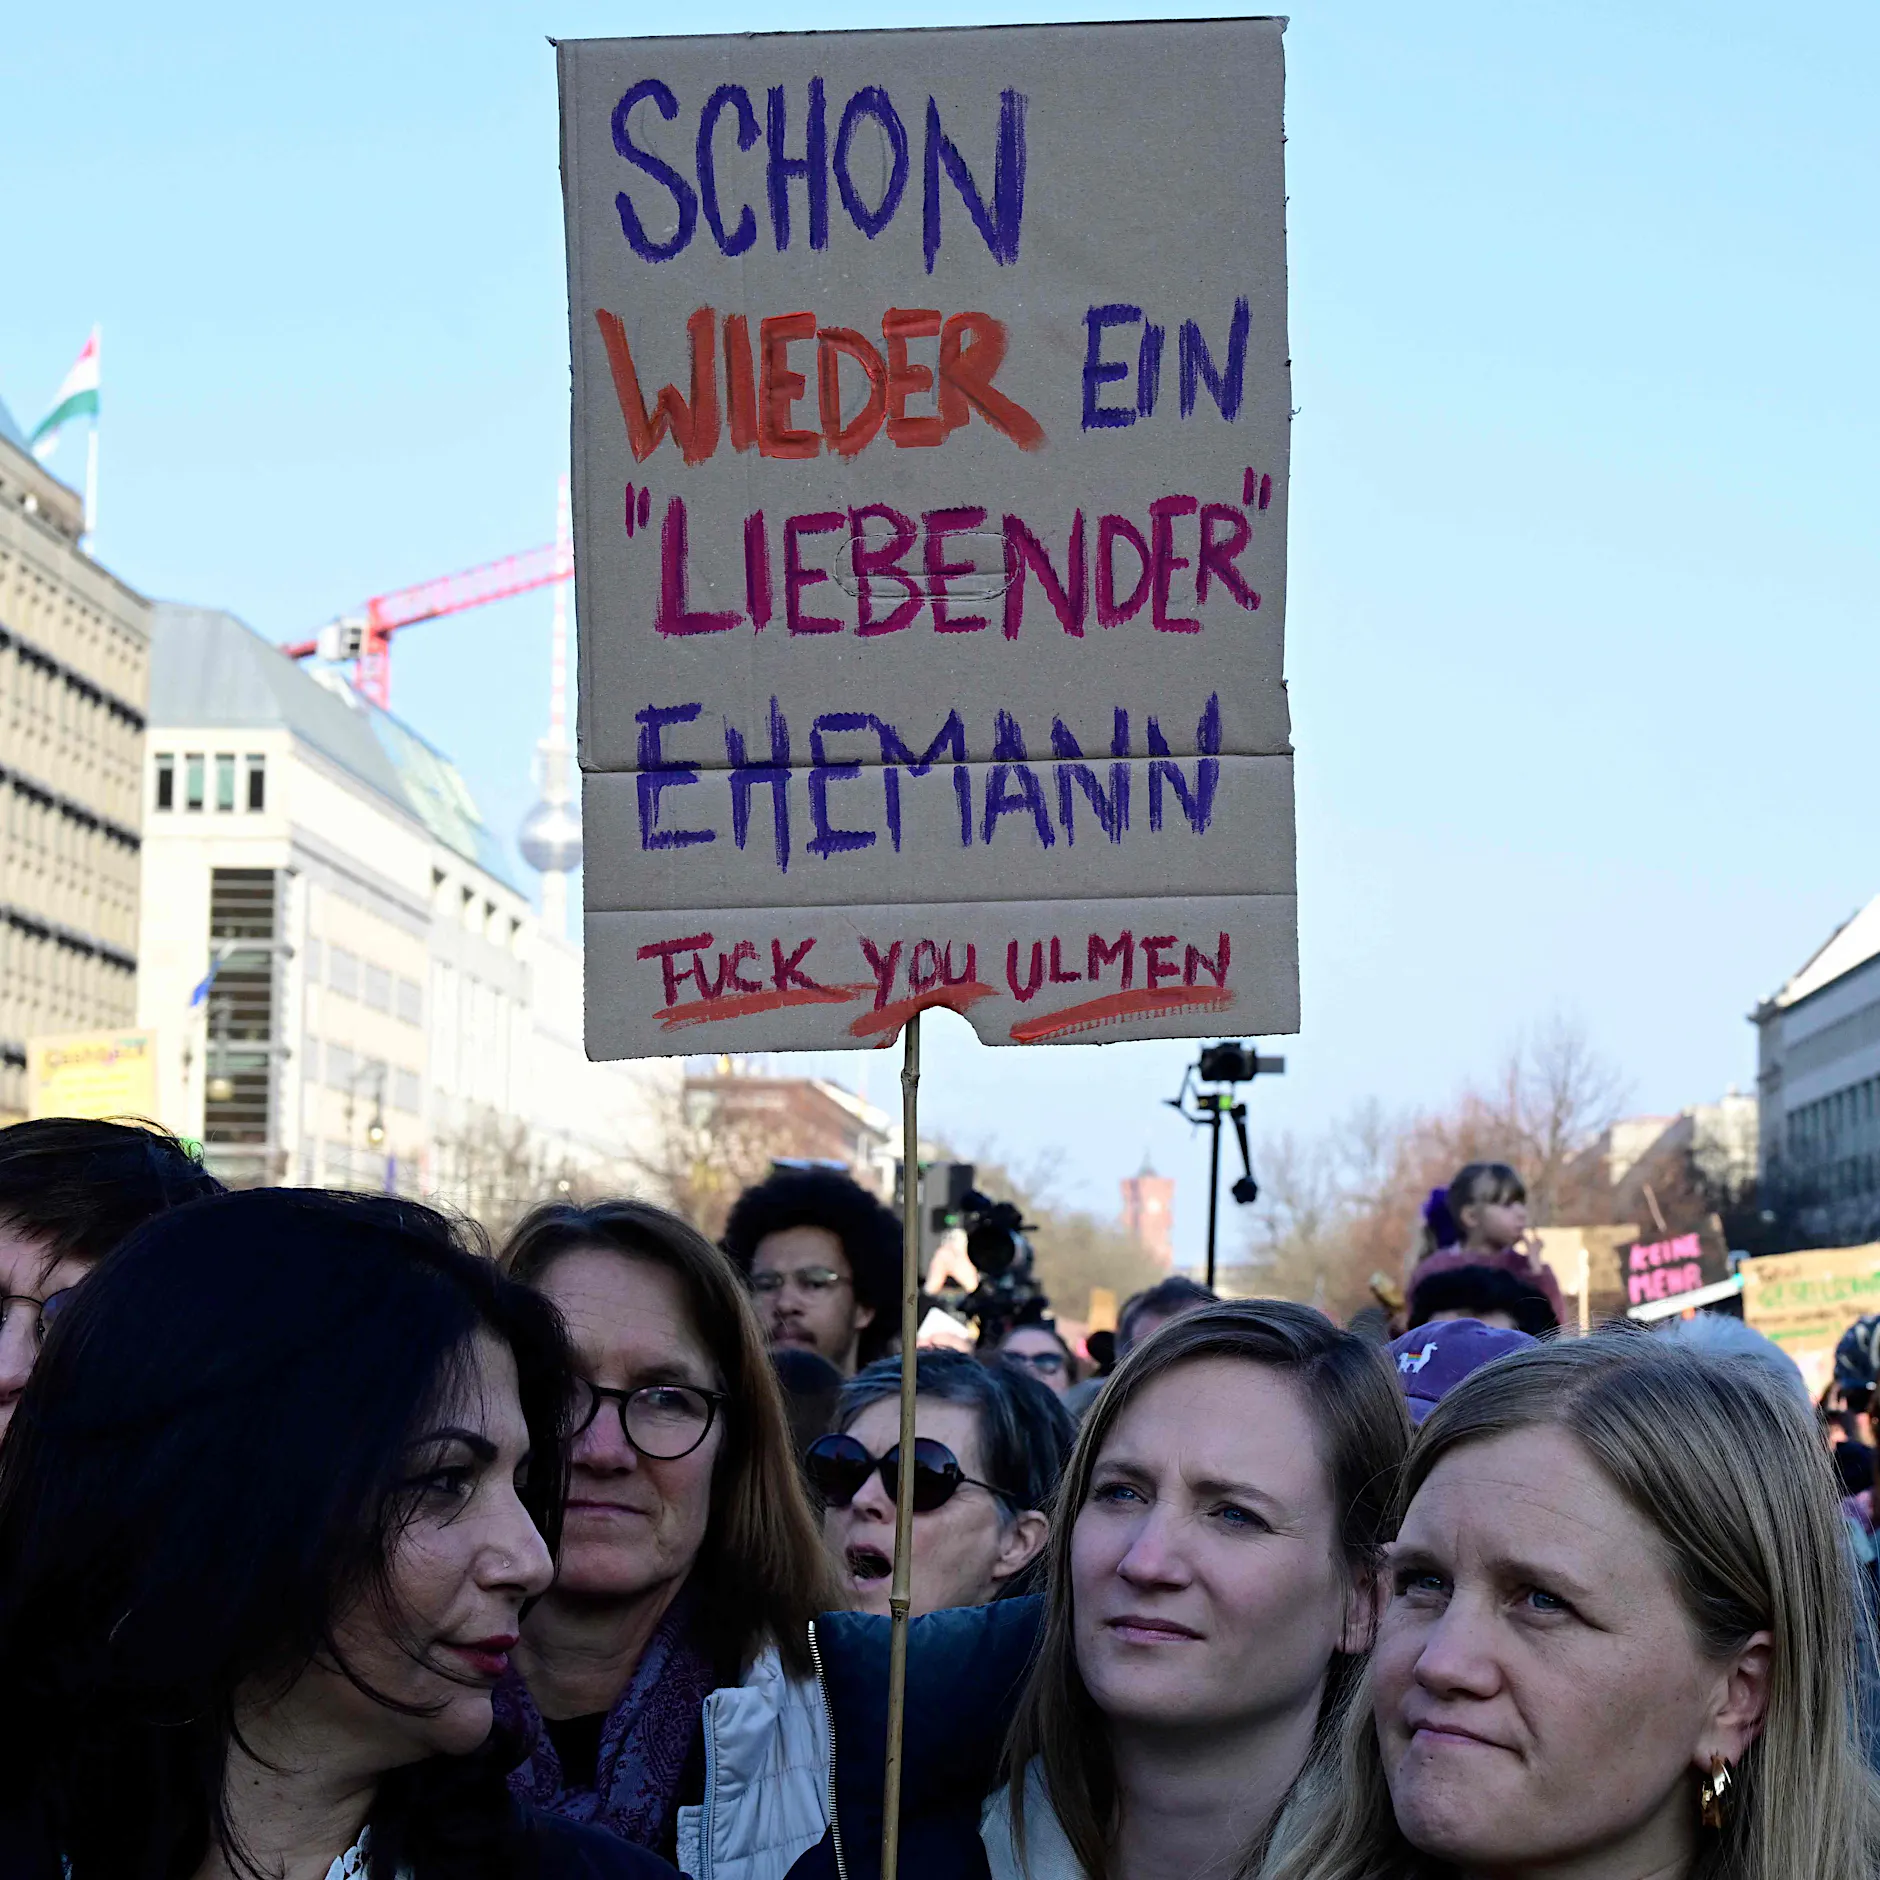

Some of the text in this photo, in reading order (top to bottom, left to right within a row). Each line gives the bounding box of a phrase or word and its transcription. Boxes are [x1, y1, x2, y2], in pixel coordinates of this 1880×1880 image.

[611, 76, 1028, 275] SCHON
[596, 296, 1251, 467] WIEDER EIN
[625, 466, 1272, 641] "LIEBENDER"
[635, 692, 1221, 874] EHEMANN
[637, 930, 1231, 1011] FUCK YOU ULMEN
